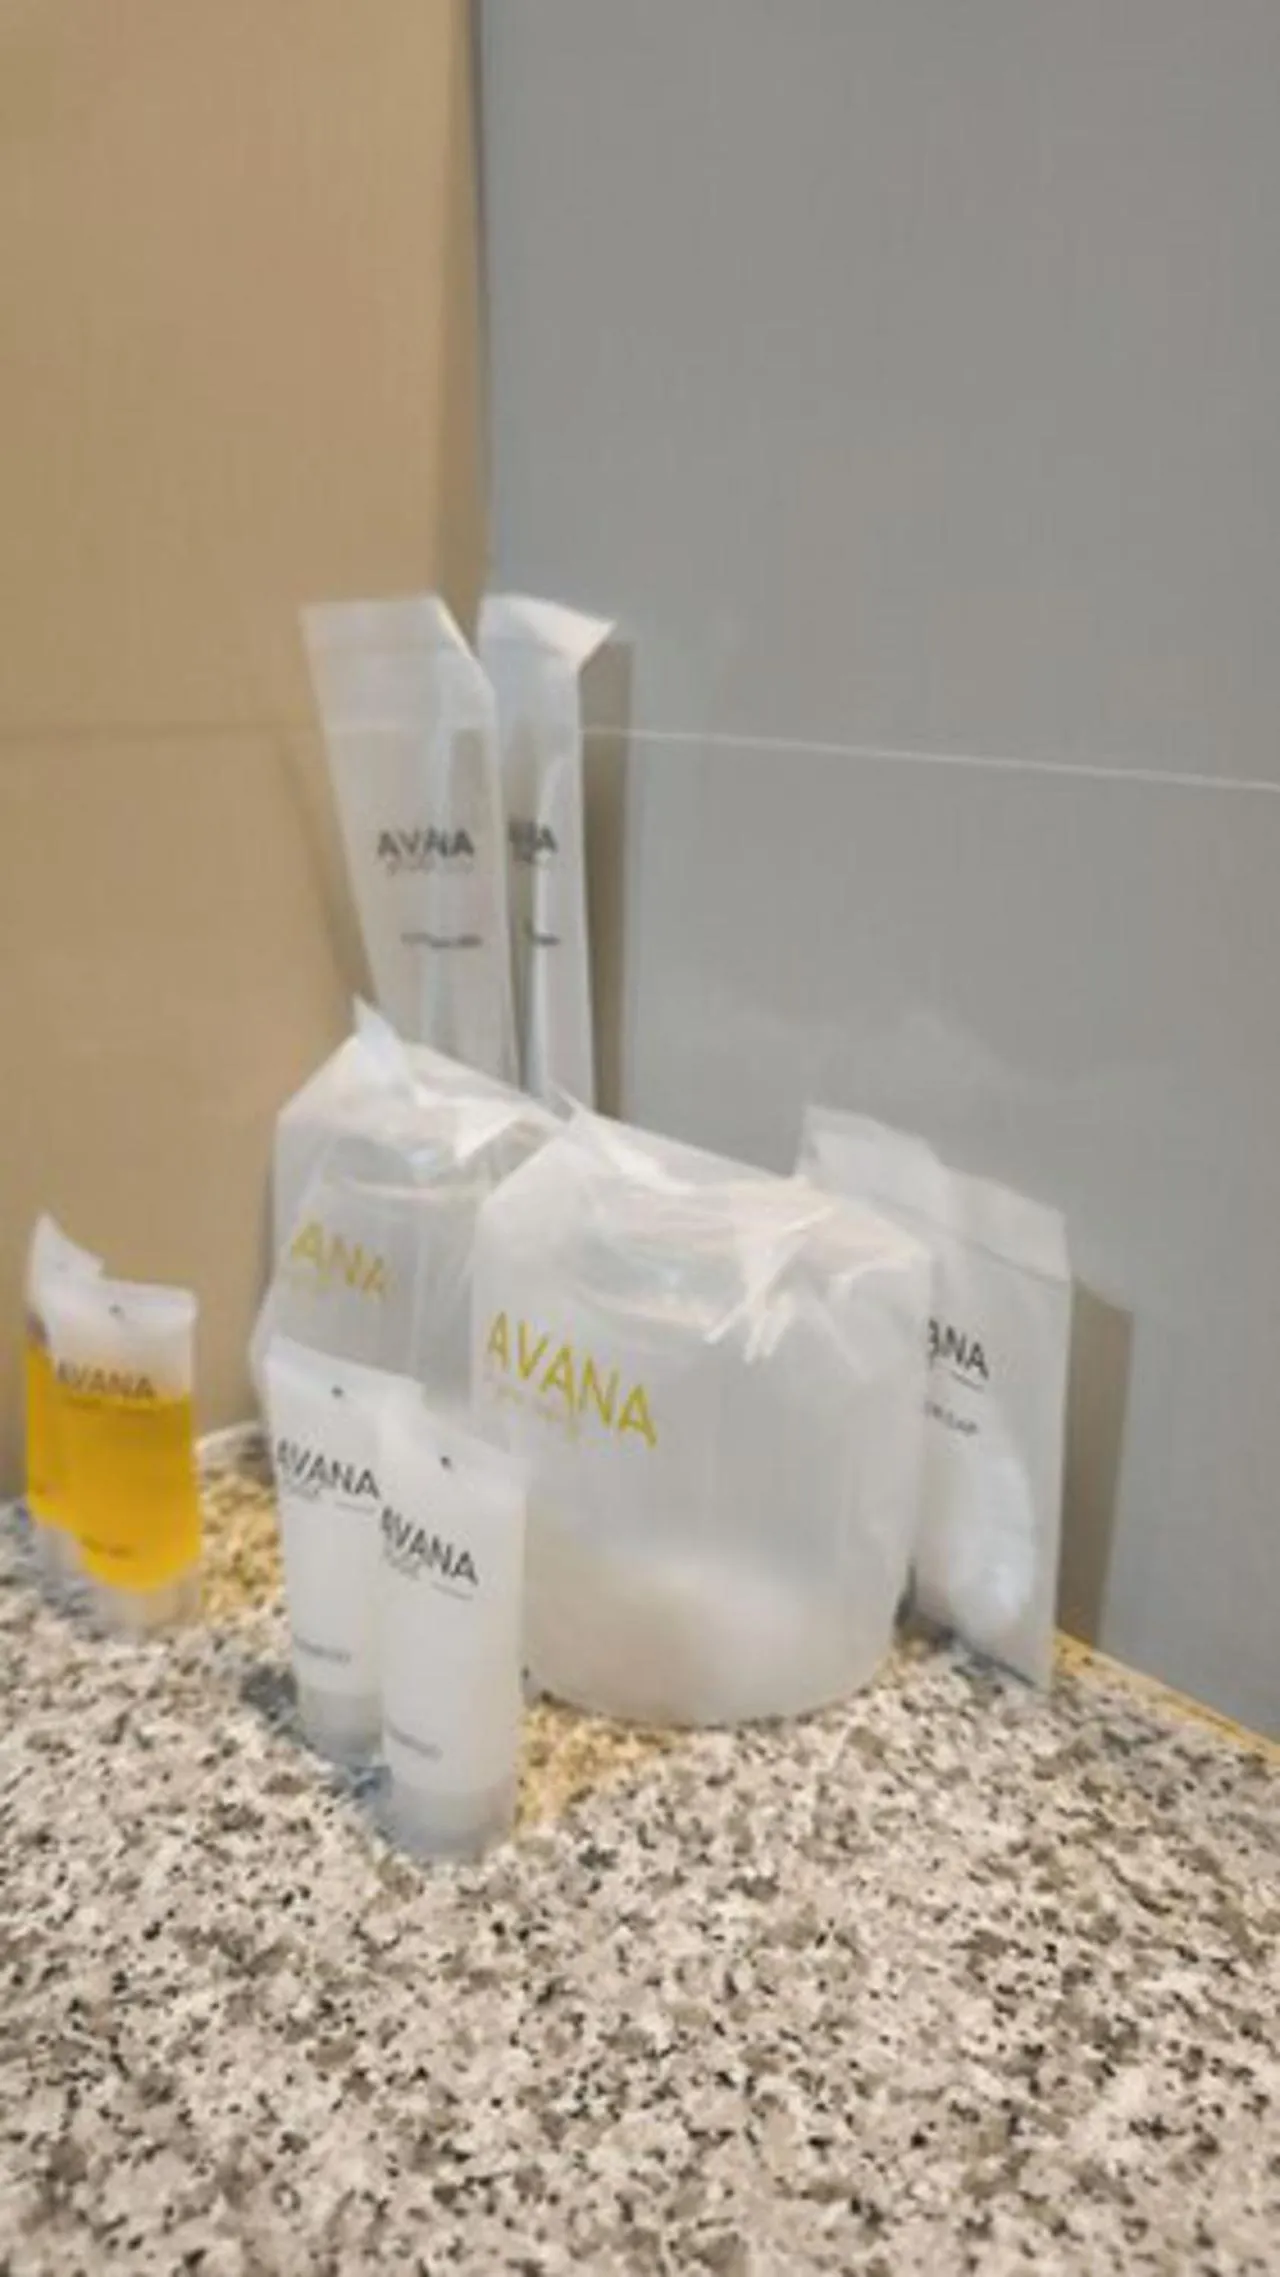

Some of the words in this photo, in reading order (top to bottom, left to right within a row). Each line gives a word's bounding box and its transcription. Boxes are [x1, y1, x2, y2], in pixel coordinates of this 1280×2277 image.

[487, 1311, 658, 1448] AVANA
[277, 1438, 381, 1499] AVANA
[381, 1505, 479, 1587] AVANA
